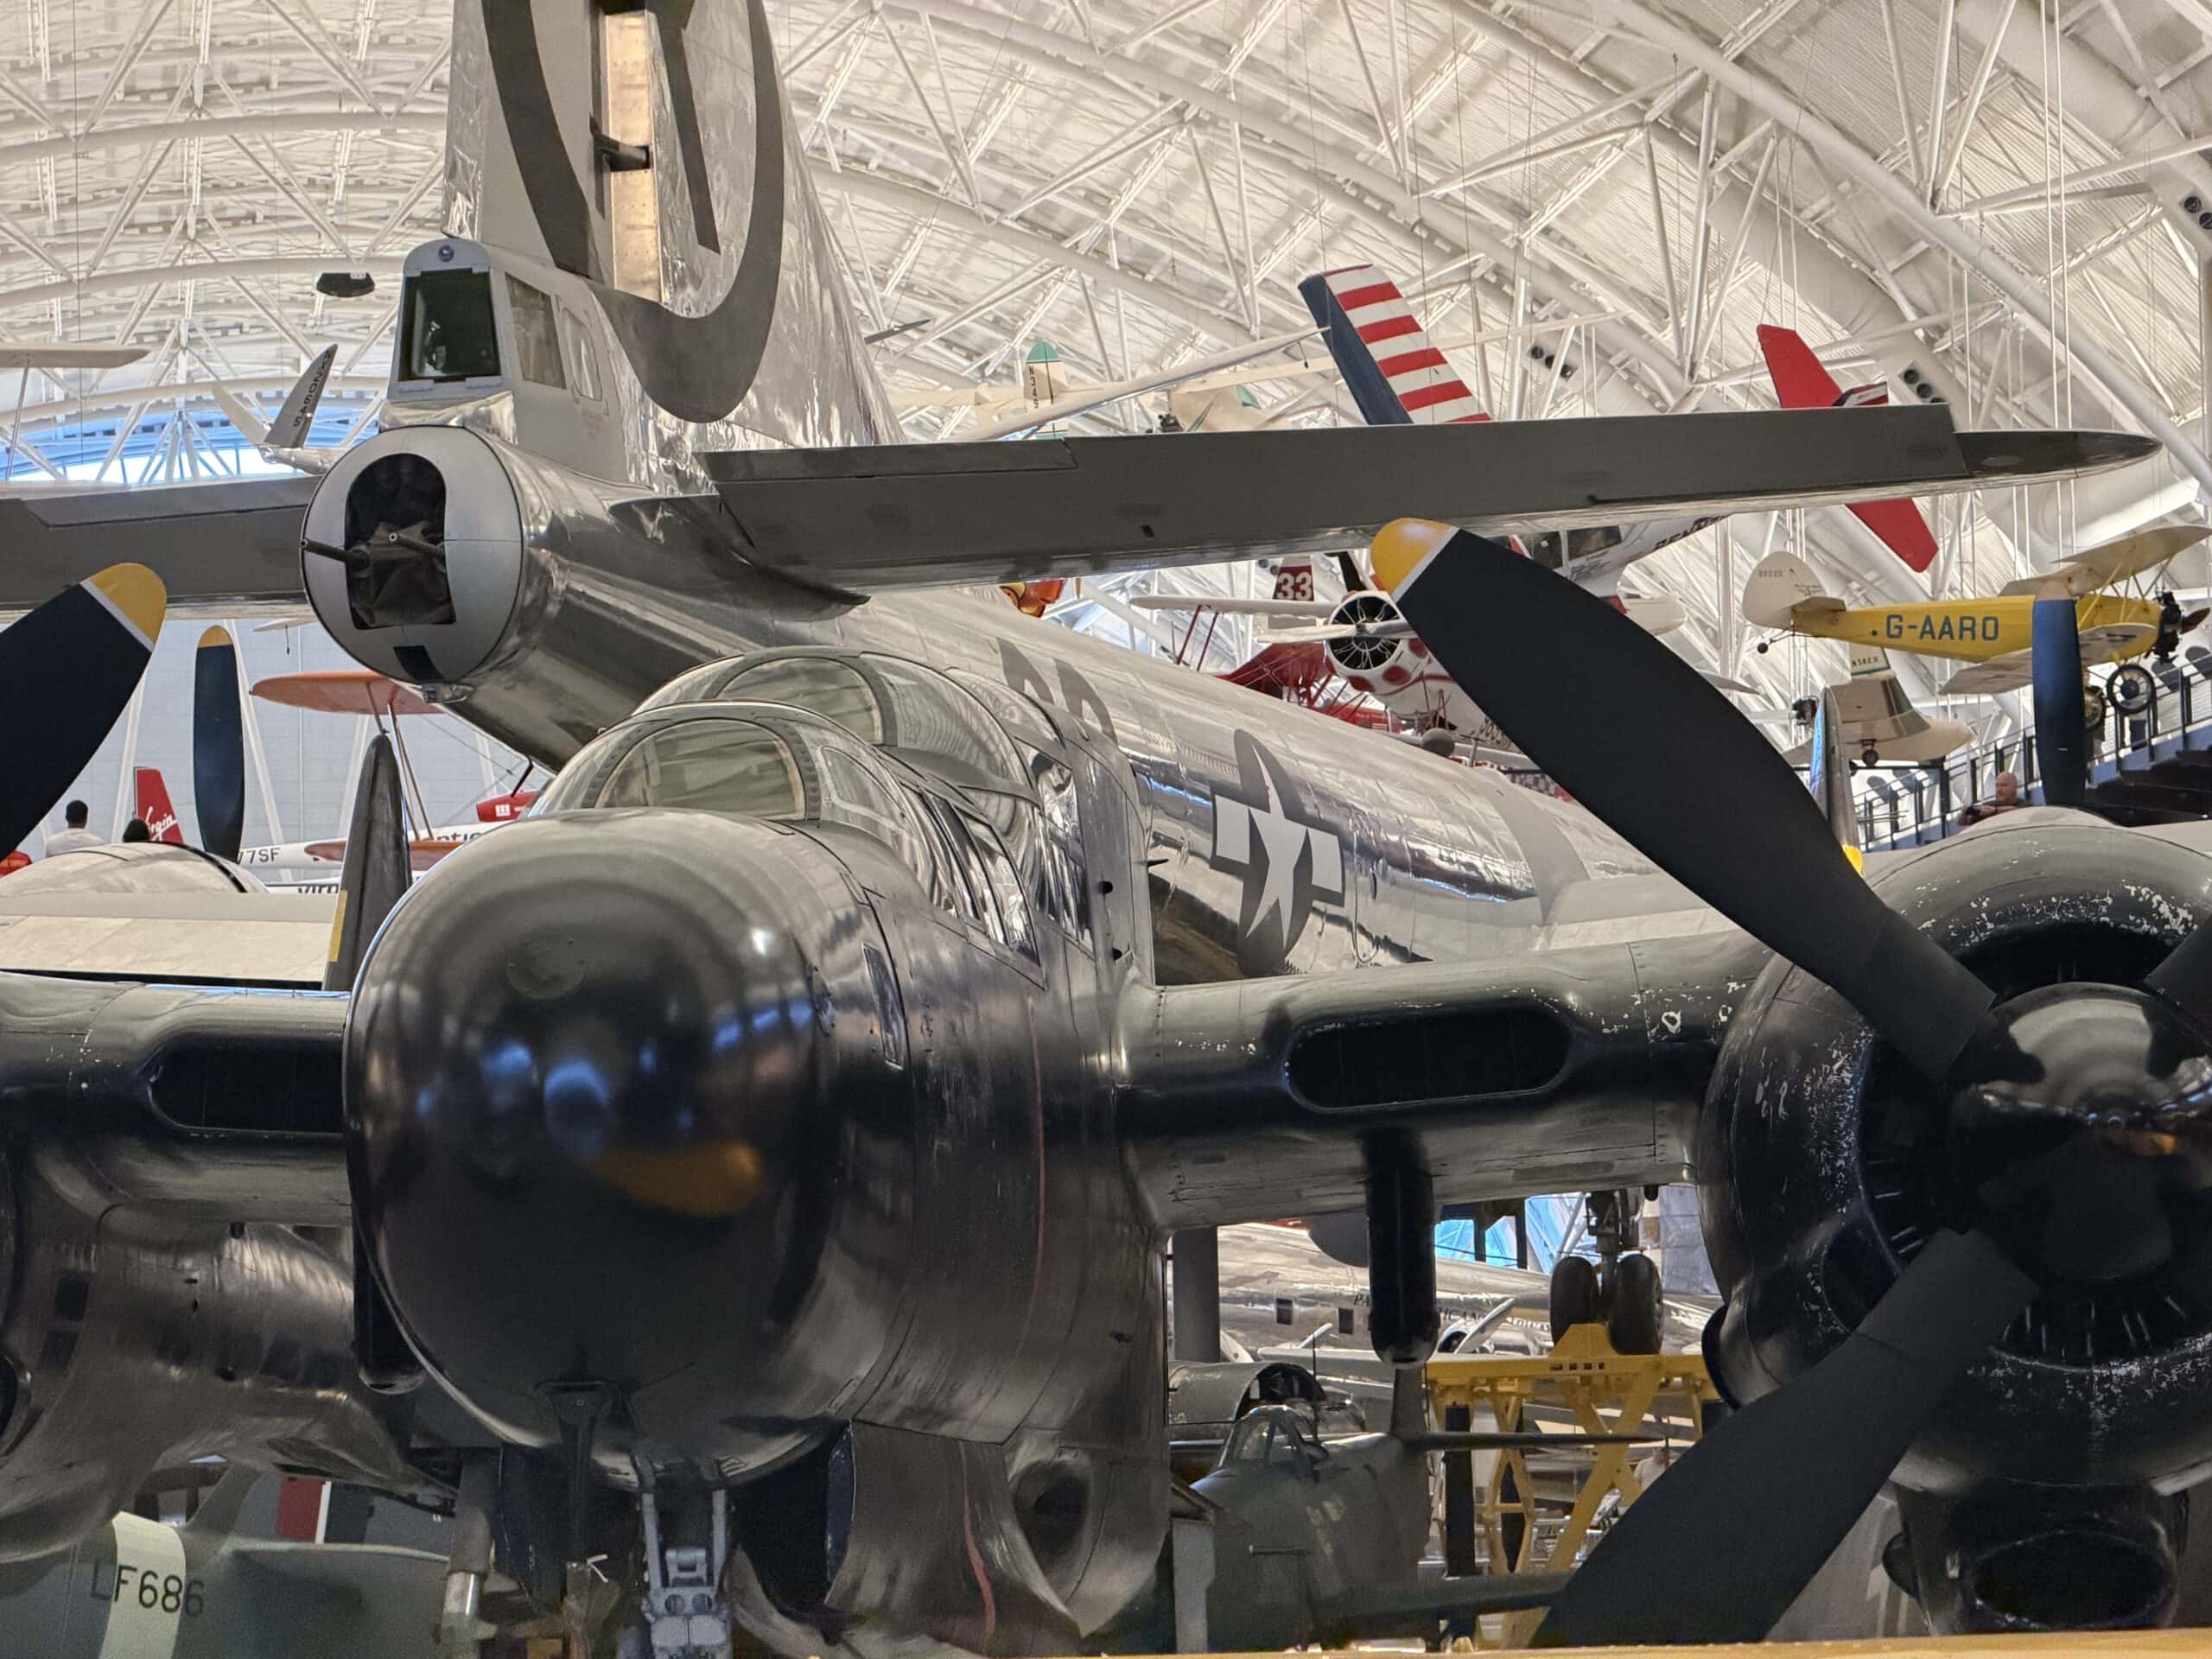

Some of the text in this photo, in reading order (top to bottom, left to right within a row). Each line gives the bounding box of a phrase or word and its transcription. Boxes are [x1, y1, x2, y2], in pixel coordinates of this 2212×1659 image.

[1277, 572, 1312, 601] 33
[1886, 614, 1999, 641] G-AARO
[1353, 1293, 1370, 1307] PA
[91, 1561, 205, 1618] LF686
